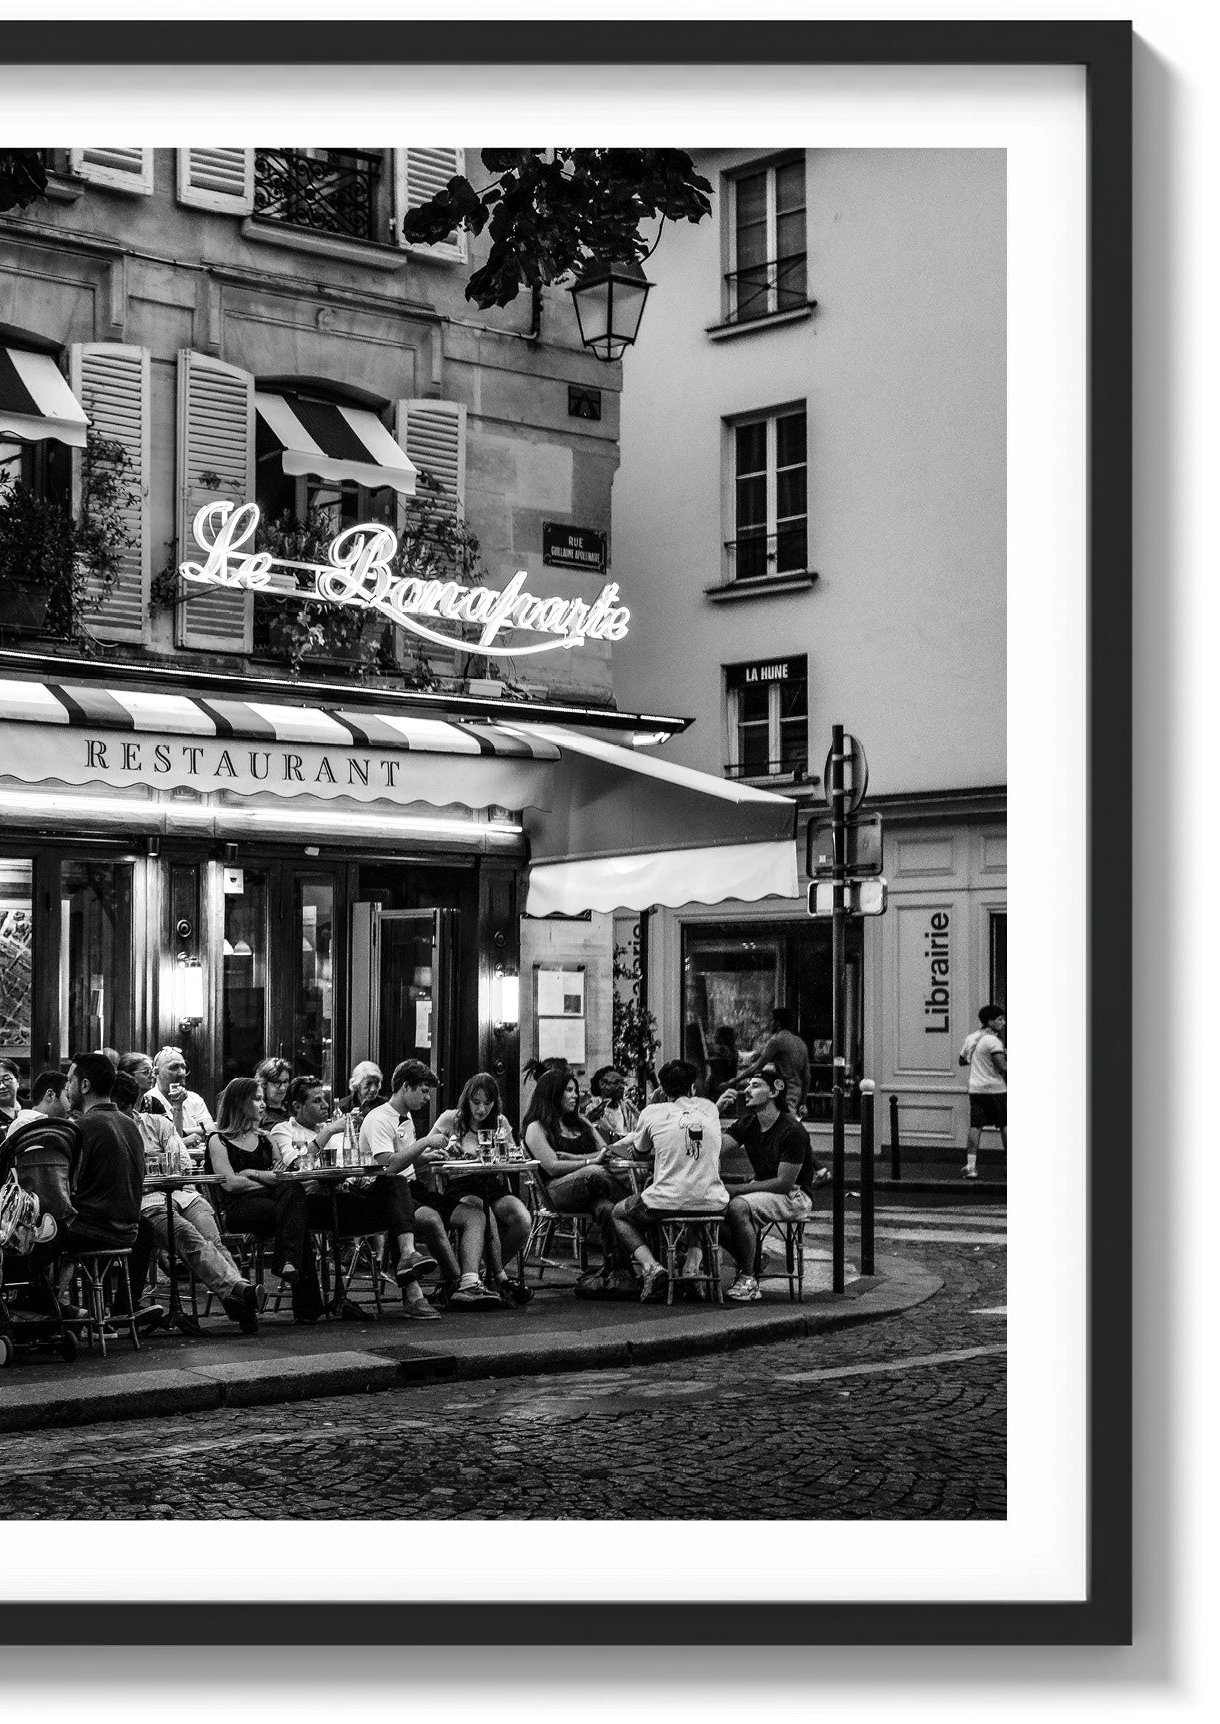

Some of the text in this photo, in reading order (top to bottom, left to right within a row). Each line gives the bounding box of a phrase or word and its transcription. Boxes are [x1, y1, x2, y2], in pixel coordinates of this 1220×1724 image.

[568, 535, 584, 549] RUE
[179, 501, 632, 655] Le Bonaparte
[746, 663, 789, 682] LA HUNE
[84, 739, 400, 788] RESTAURANT
[924, 911, 950, 1034] Librairie
